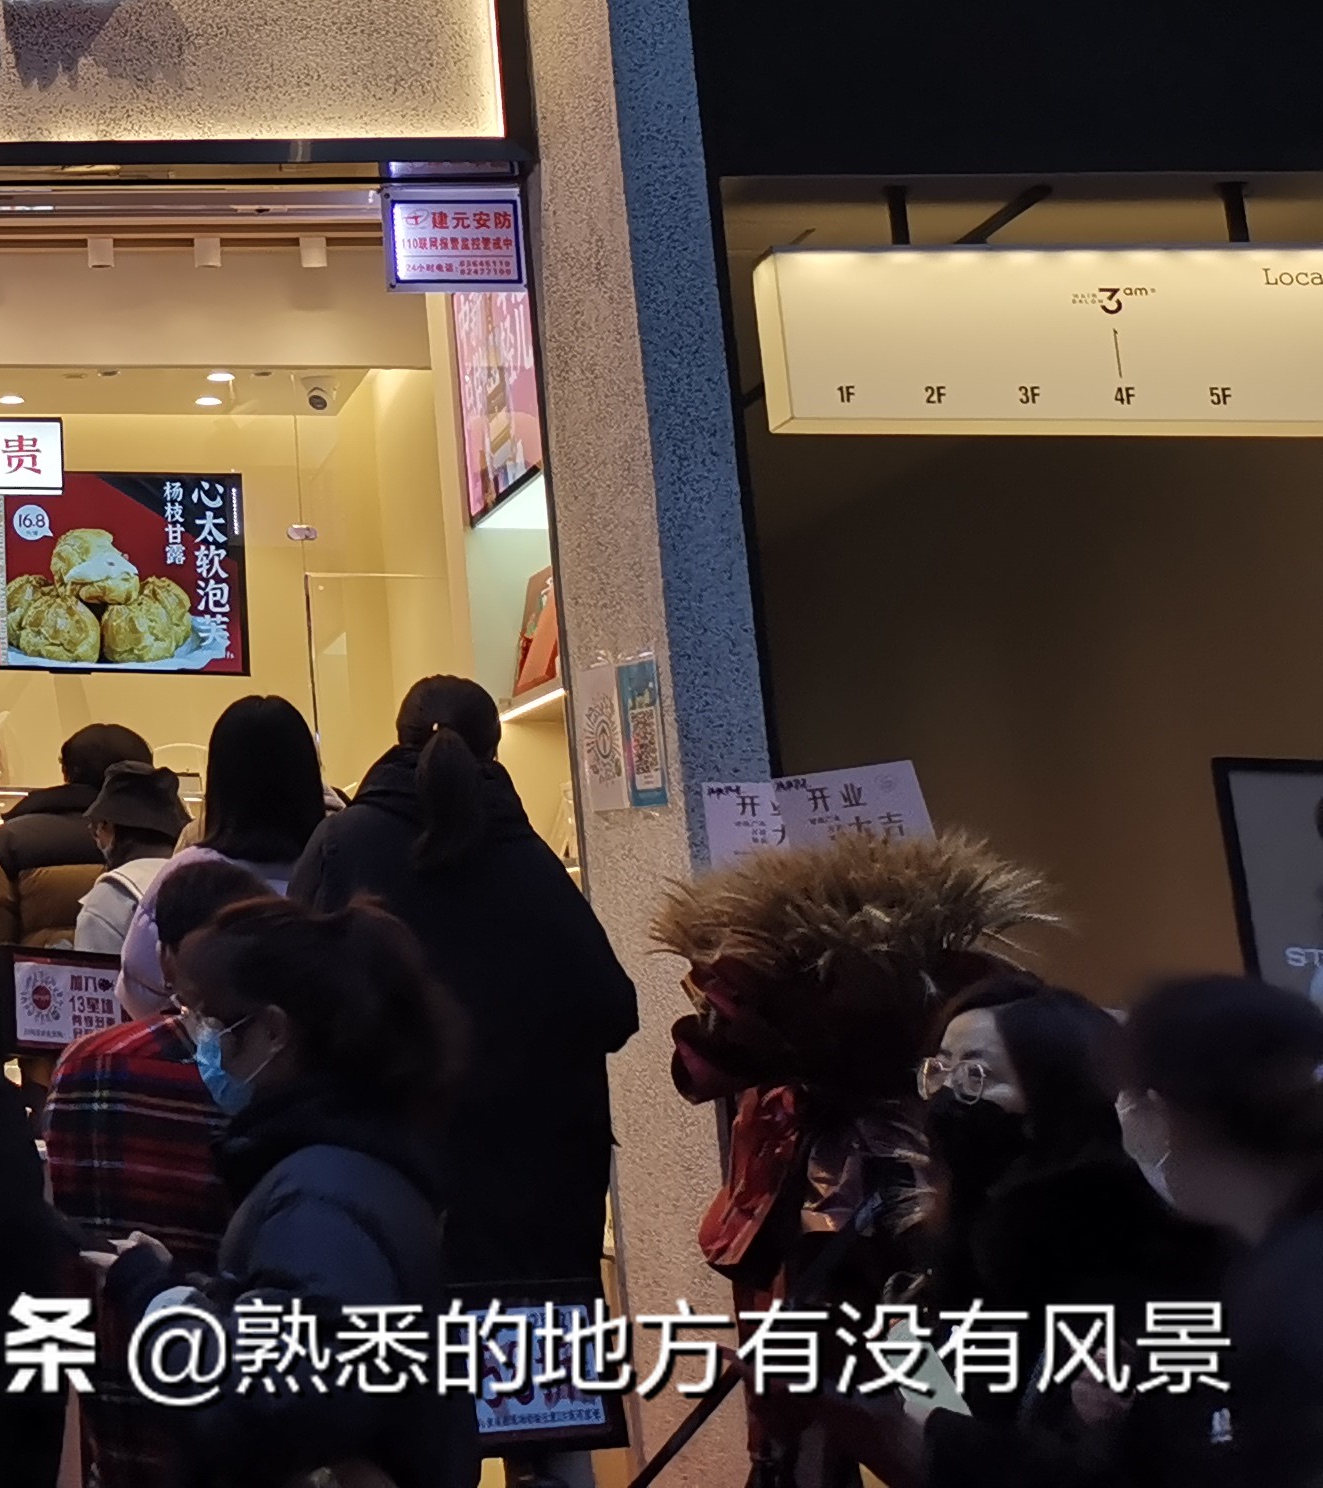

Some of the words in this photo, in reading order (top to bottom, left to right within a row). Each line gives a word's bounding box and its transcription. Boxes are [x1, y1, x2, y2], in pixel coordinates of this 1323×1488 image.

[431, 210, 512, 230] 建元安防
[836, 385, 856, 404] 1F
[924, 385, 947, 405] 2F
[1018, 385, 1041, 405] 3F
[1114, 386, 1137, 406] 4F
[1209, 386, 1232, 406] 5F
[18, 513, 46, 528] 16.8
[163, 480, 187, 565] 杨枝甘露
[191, 480, 232, 649] 心太软泡芙
[807, 782, 868, 811] 开业
